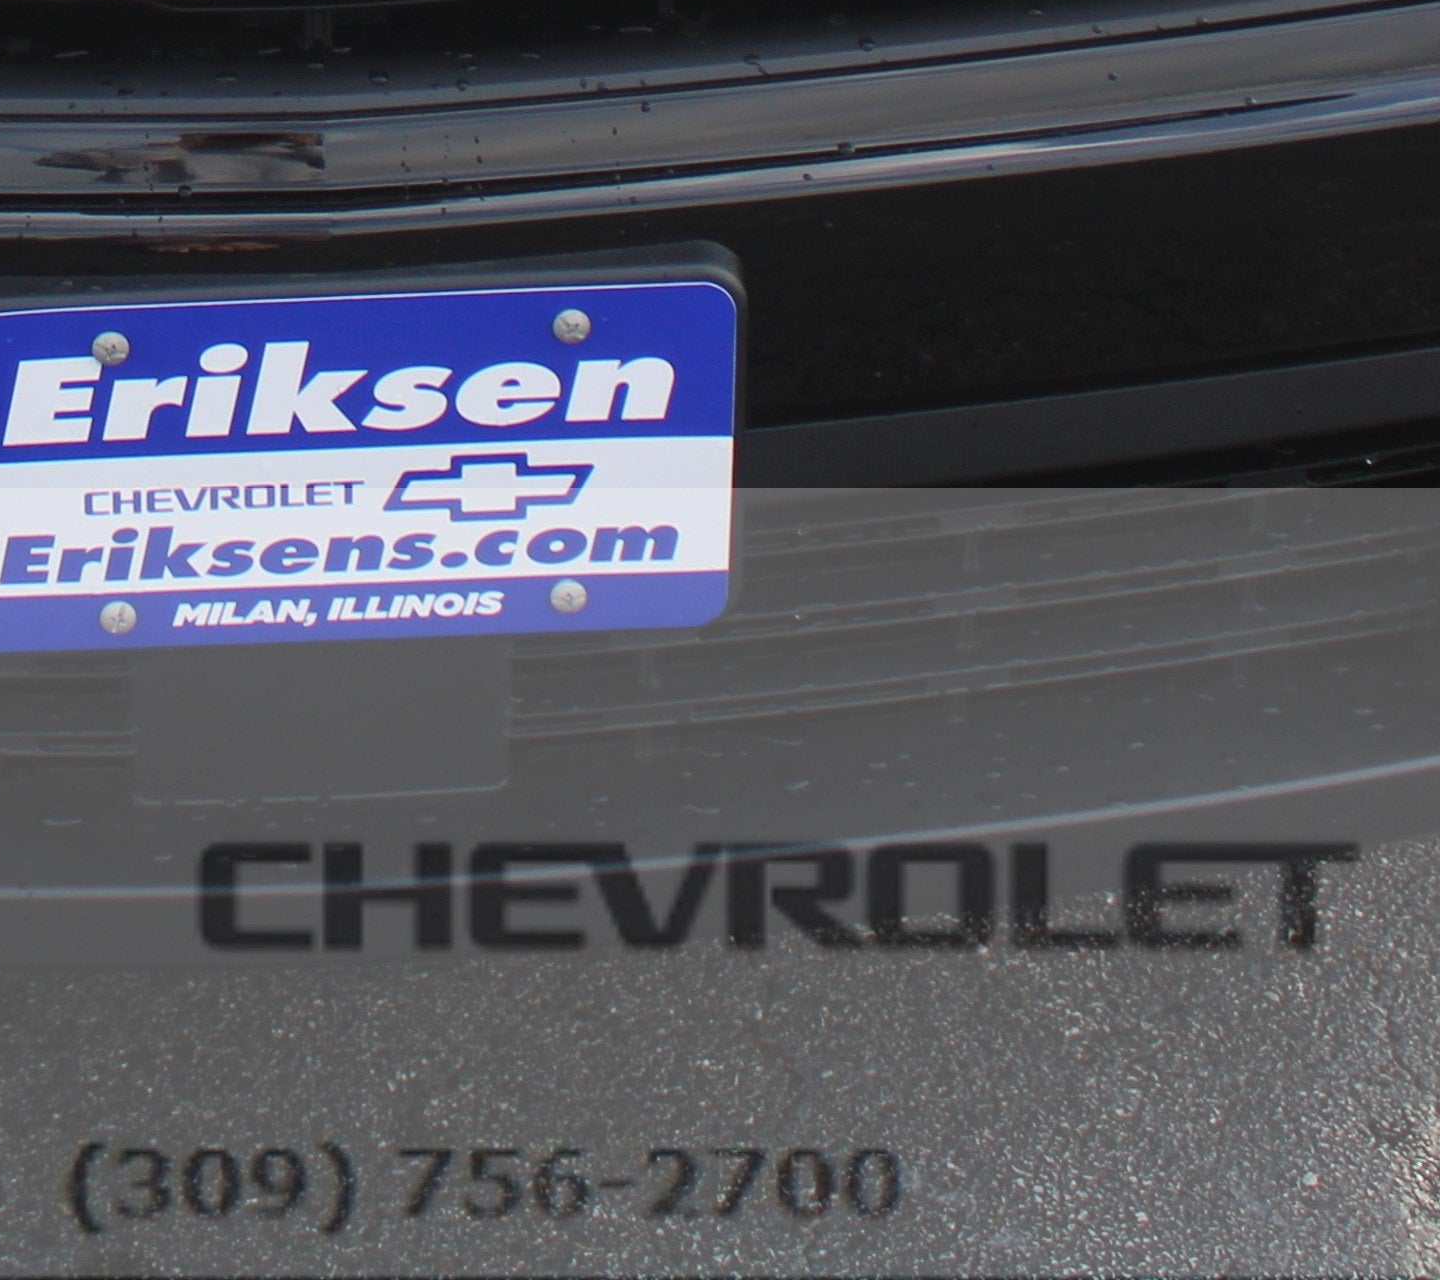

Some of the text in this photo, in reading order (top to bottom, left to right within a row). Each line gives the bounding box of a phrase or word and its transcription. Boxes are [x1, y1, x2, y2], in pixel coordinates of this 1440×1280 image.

[1, 340, 677, 447] Eriksen
[83, 480, 365, 516] CHEVROLET
[172, 590, 505, 628] MILAN, ILLINOIS
